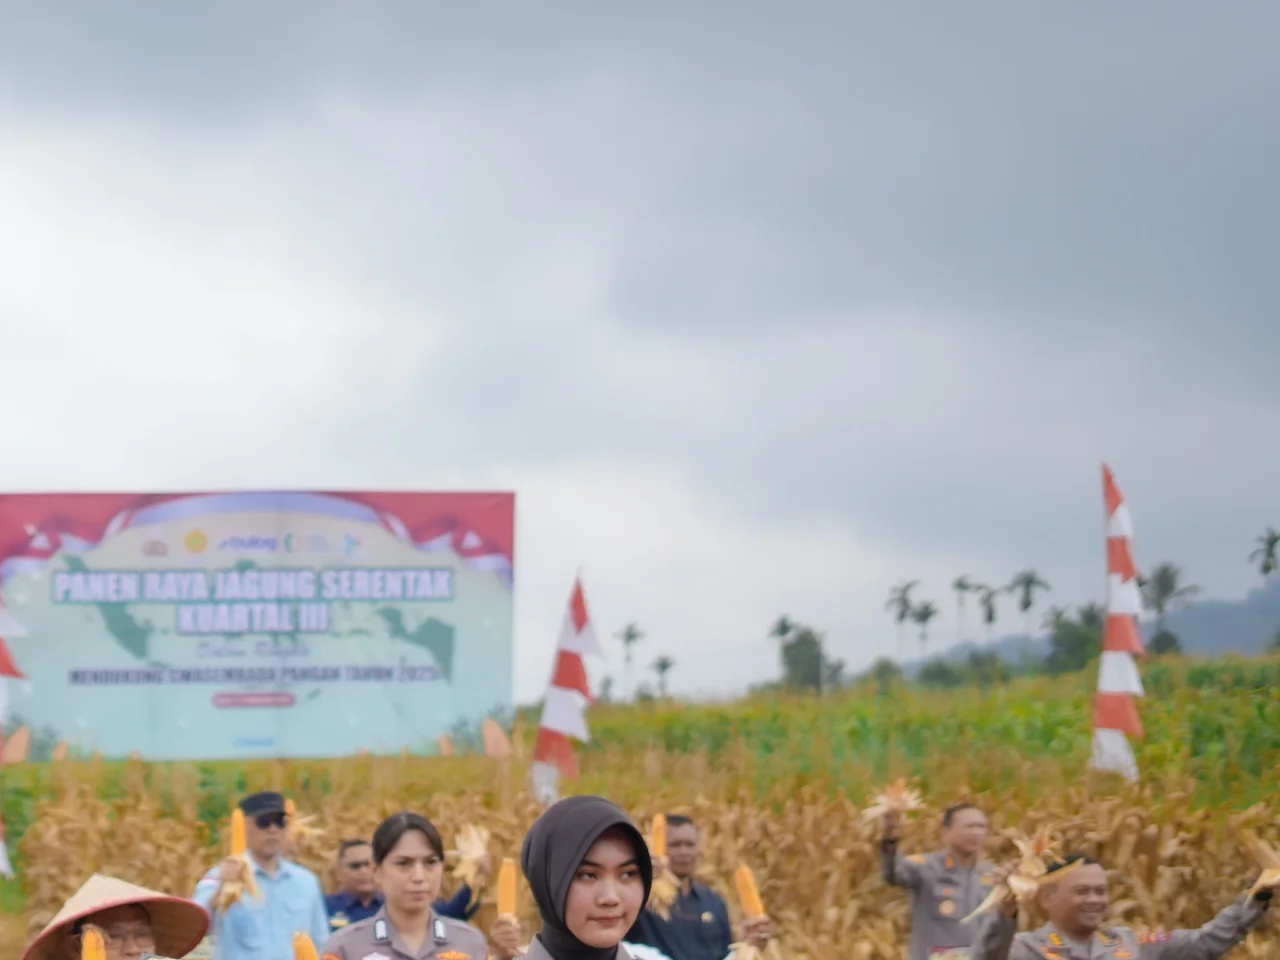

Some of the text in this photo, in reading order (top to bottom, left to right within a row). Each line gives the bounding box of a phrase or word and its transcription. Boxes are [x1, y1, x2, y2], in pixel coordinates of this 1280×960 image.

[54, 569, 452, 600] PANEN RAYA JAGUNG SERENTAK
[179, 603, 329, 633] KUARTAL III
